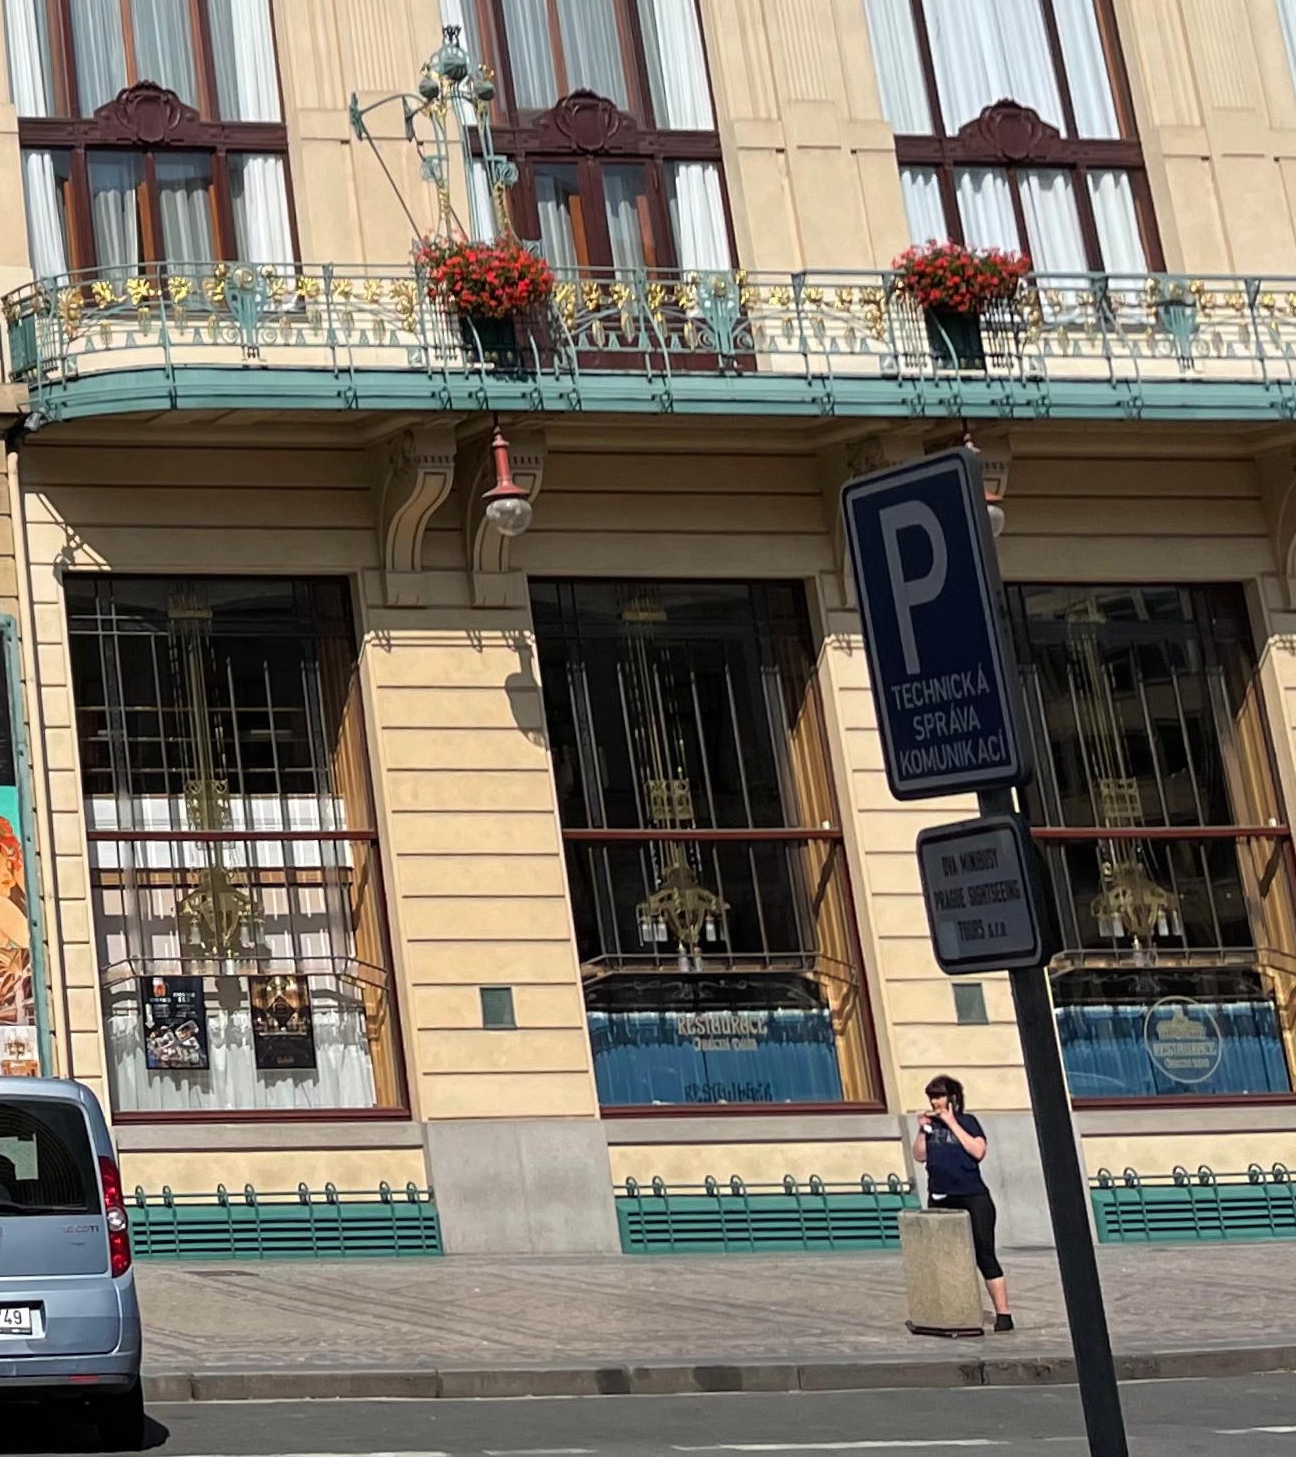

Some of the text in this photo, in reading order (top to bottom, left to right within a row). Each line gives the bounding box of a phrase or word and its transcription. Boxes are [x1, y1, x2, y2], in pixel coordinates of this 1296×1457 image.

[879, 499, 949, 676] P
[891, 662, 990, 711] TECHNICKÁ
[913, 703, 981, 741] SPRÁVA
[899, 728, 1006, 777] KOMUNIKACÍ
